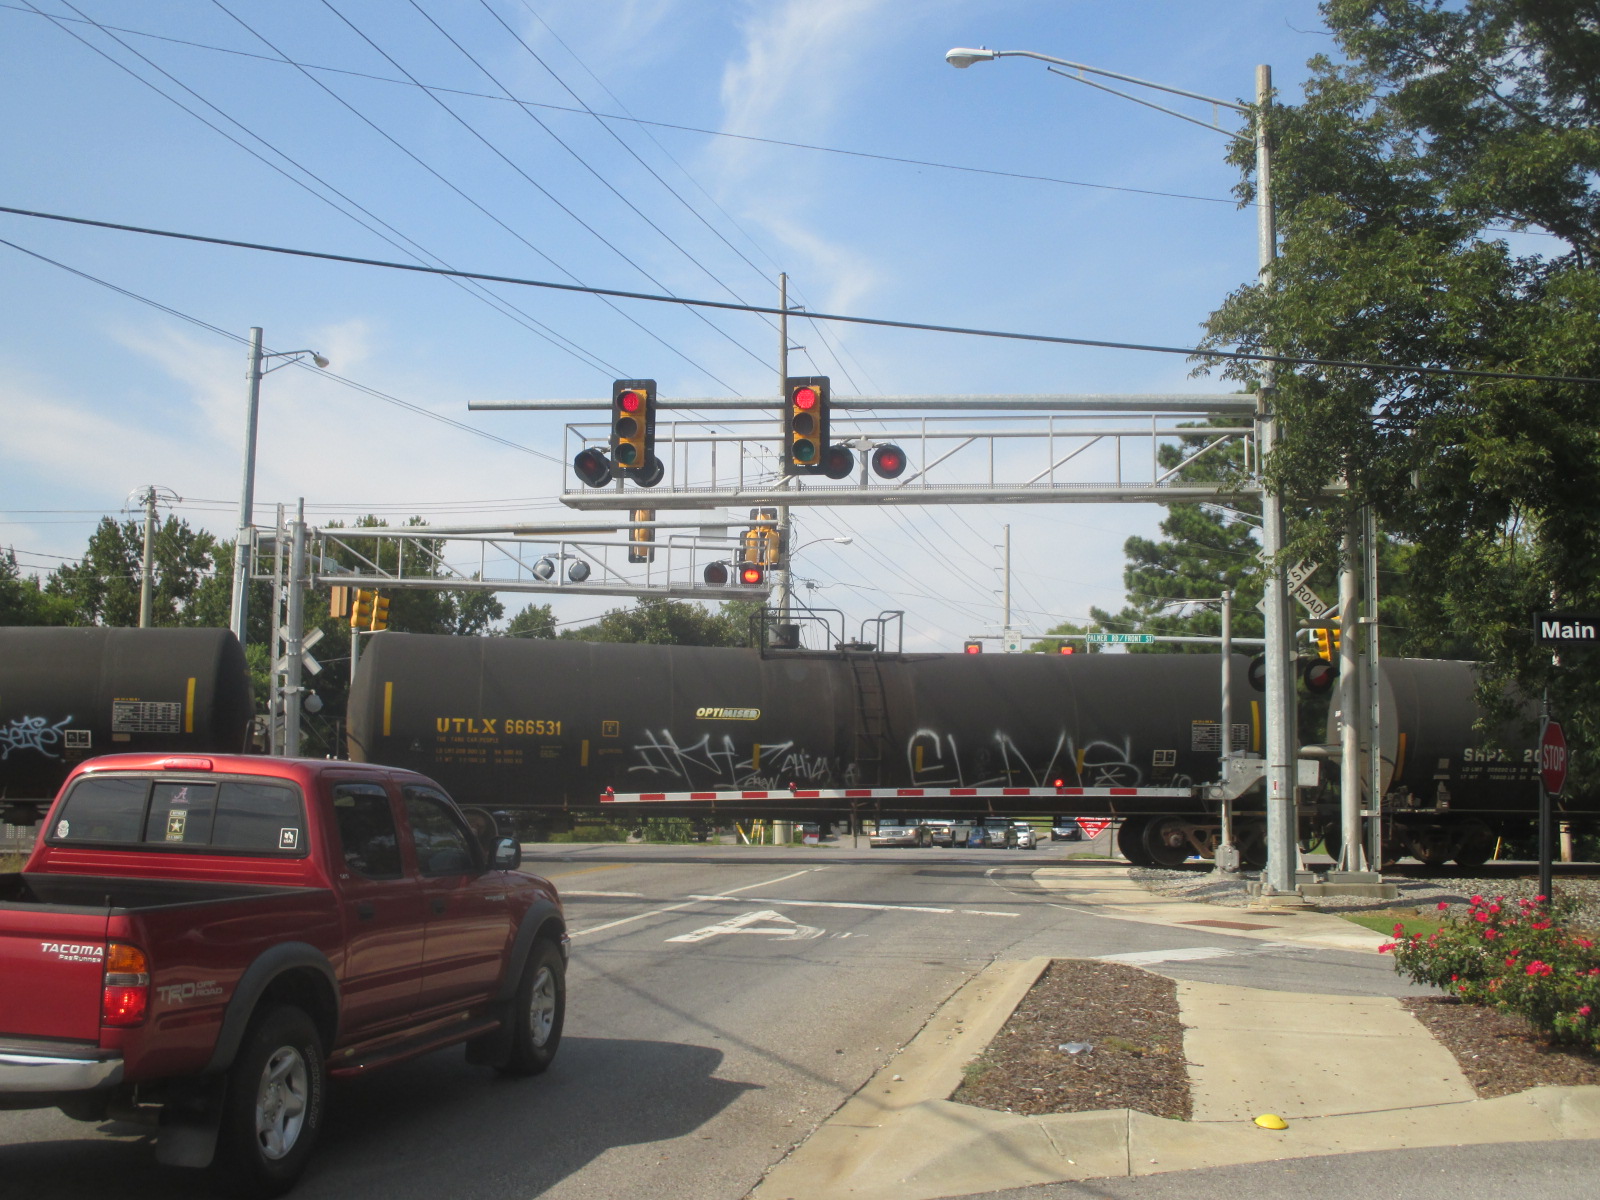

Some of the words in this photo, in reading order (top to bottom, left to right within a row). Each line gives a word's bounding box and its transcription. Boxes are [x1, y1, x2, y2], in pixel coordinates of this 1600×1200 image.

[1295, 586, 1323, 614] ROAD
[1087, 634, 1108, 642] PALMER
[1111, 634, 1141, 642] RD/FRONT
[1145, 635, 1153, 643] ST
[1541, 621, 1595, 639] Main
[696, 707, 760, 719] OPTIMISER
[436, 717, 497, 734] UTLX
[505, 719, 561, 736] 666531
[1543, 744, 1565, 772] STOP
[41, 942, 104, 956] TACOMA
[156, 982, 196, 1005] TRD
[196, 980, 217, 989] OFF
[196, 987, 224, 996] ROAD
